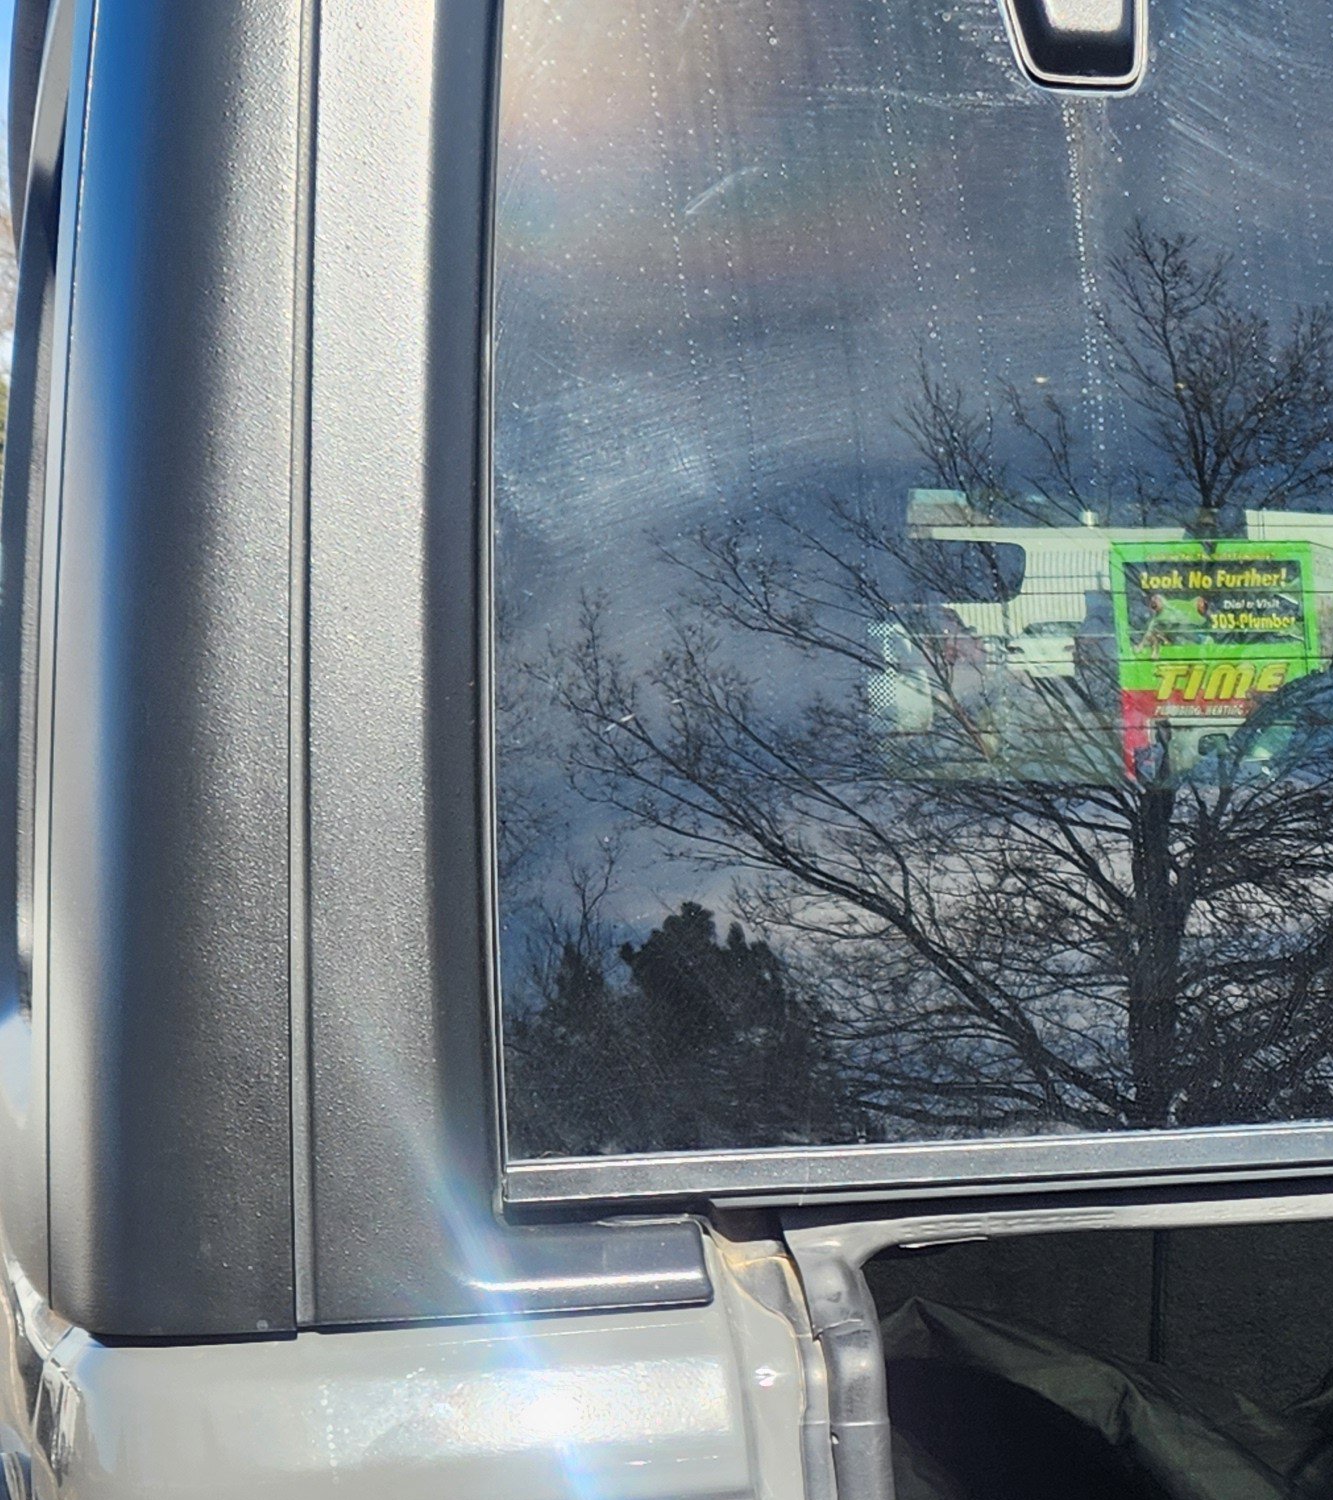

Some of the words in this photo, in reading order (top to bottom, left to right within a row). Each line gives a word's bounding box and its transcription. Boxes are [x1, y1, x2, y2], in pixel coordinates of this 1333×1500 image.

[1141, 569, 1183, 589] Look
[1188, 571, 1213, 589] No
[1216, 567, 1287, 589] Further!
[1223, 600, 1245, 610] Dial
[1256, 599, 1280, 610] Visit
[1211, 612, 1296, 630] 303-Plumber
[1155, 662, 1290, 701] TIME
